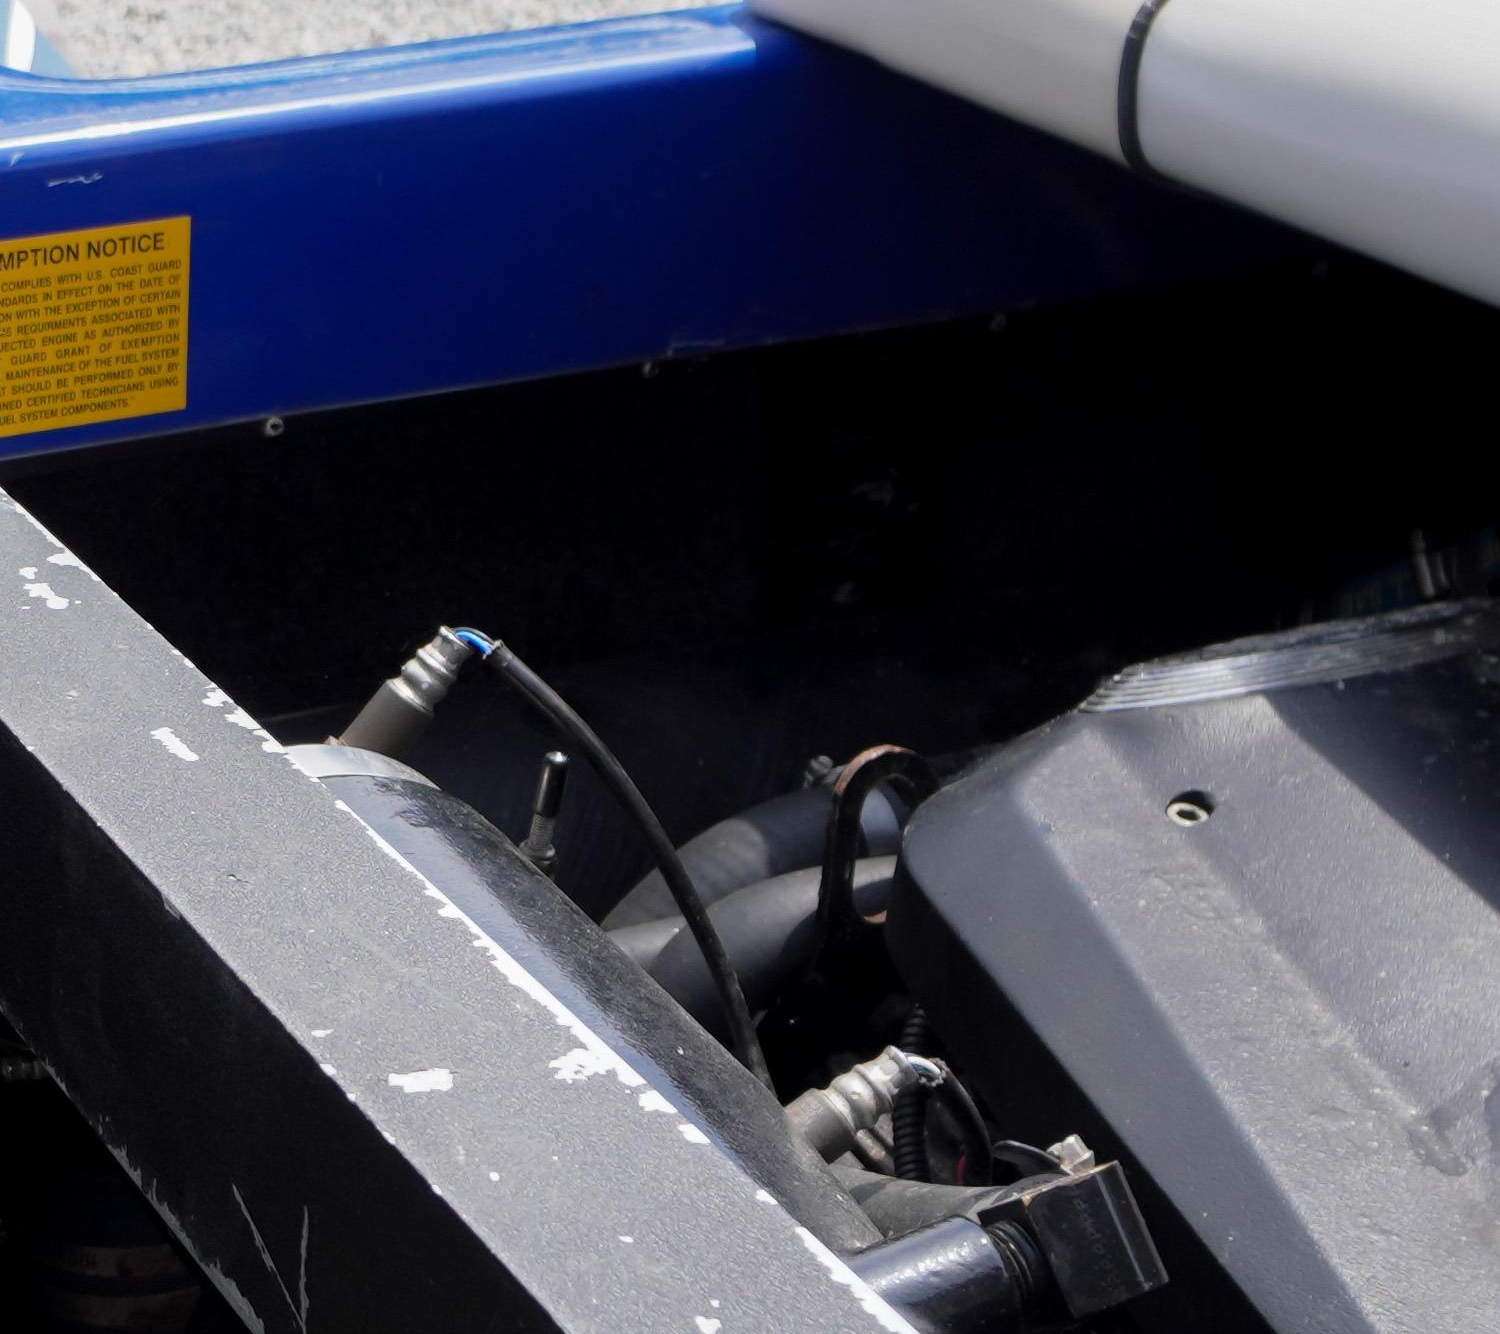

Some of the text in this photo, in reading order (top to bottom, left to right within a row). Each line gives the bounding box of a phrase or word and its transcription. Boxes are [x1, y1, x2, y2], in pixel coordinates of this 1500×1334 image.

[87, 233, 165, 259] NOTICE
[1, 276, 52, 293] COMPLIES
[57, 273, 81, 284] WITH
[110, 264, 143, 278] COAST
[147, 259, 182, 272] GUARD
[43, 292, 53, 301] IN
[57, 286, 93, 300] EFFECT
[97, 283, 112, 294] ON
[117, 280, 134, 291] THE
[140, 276, 163, 289] DATE
[168, 274, 181, 285] OF
[16, 308, 41, 320] WITH
[44, 304, 62, 316] THE
[66, 296, 120, 314] EXCEPTION
[123, 295, 137, 305] OF
[140, 290, 181, 303] CERTAIN
[91, 308, 153, 325] ASSOCIATED
[156, 304, 180, 315] WITH
[42, 332, 78, 347] ENGINE
[84, 330, 97, 341] AS
[102, 321, 163, 337] AUTHORIZED
[168, 318, 180, 329] BY
[6, 361, 75, 381] MAINTENANCE
[78, 360, 91, 371] OF
[95, 356, 113, 368] THE
[115, 354, 139, 365] FUEL
[142, 347, 180, 362] SYSTEM
[10, 351, 47, 366] GUARD
[56, 345, 90, 359] GRANT
[98, 342, 113, 353] OF
[121, 333, 180, 350] EXEMPTION
[11, 380, 52, 395] SHOULD
[57, 378, 69, 388] BE
[73, 369, 134, 386] PERFORMED
[138, 364, 163, 377] ONLY
[167, 362, 180, 373] BY
[26, 392, 76, 408] CERTIFIED
[80, 381, 145, 399] TECHNICIANS
[149, 376, 179, 389] USING
[20, 409, 58, 422] SYSTEM
